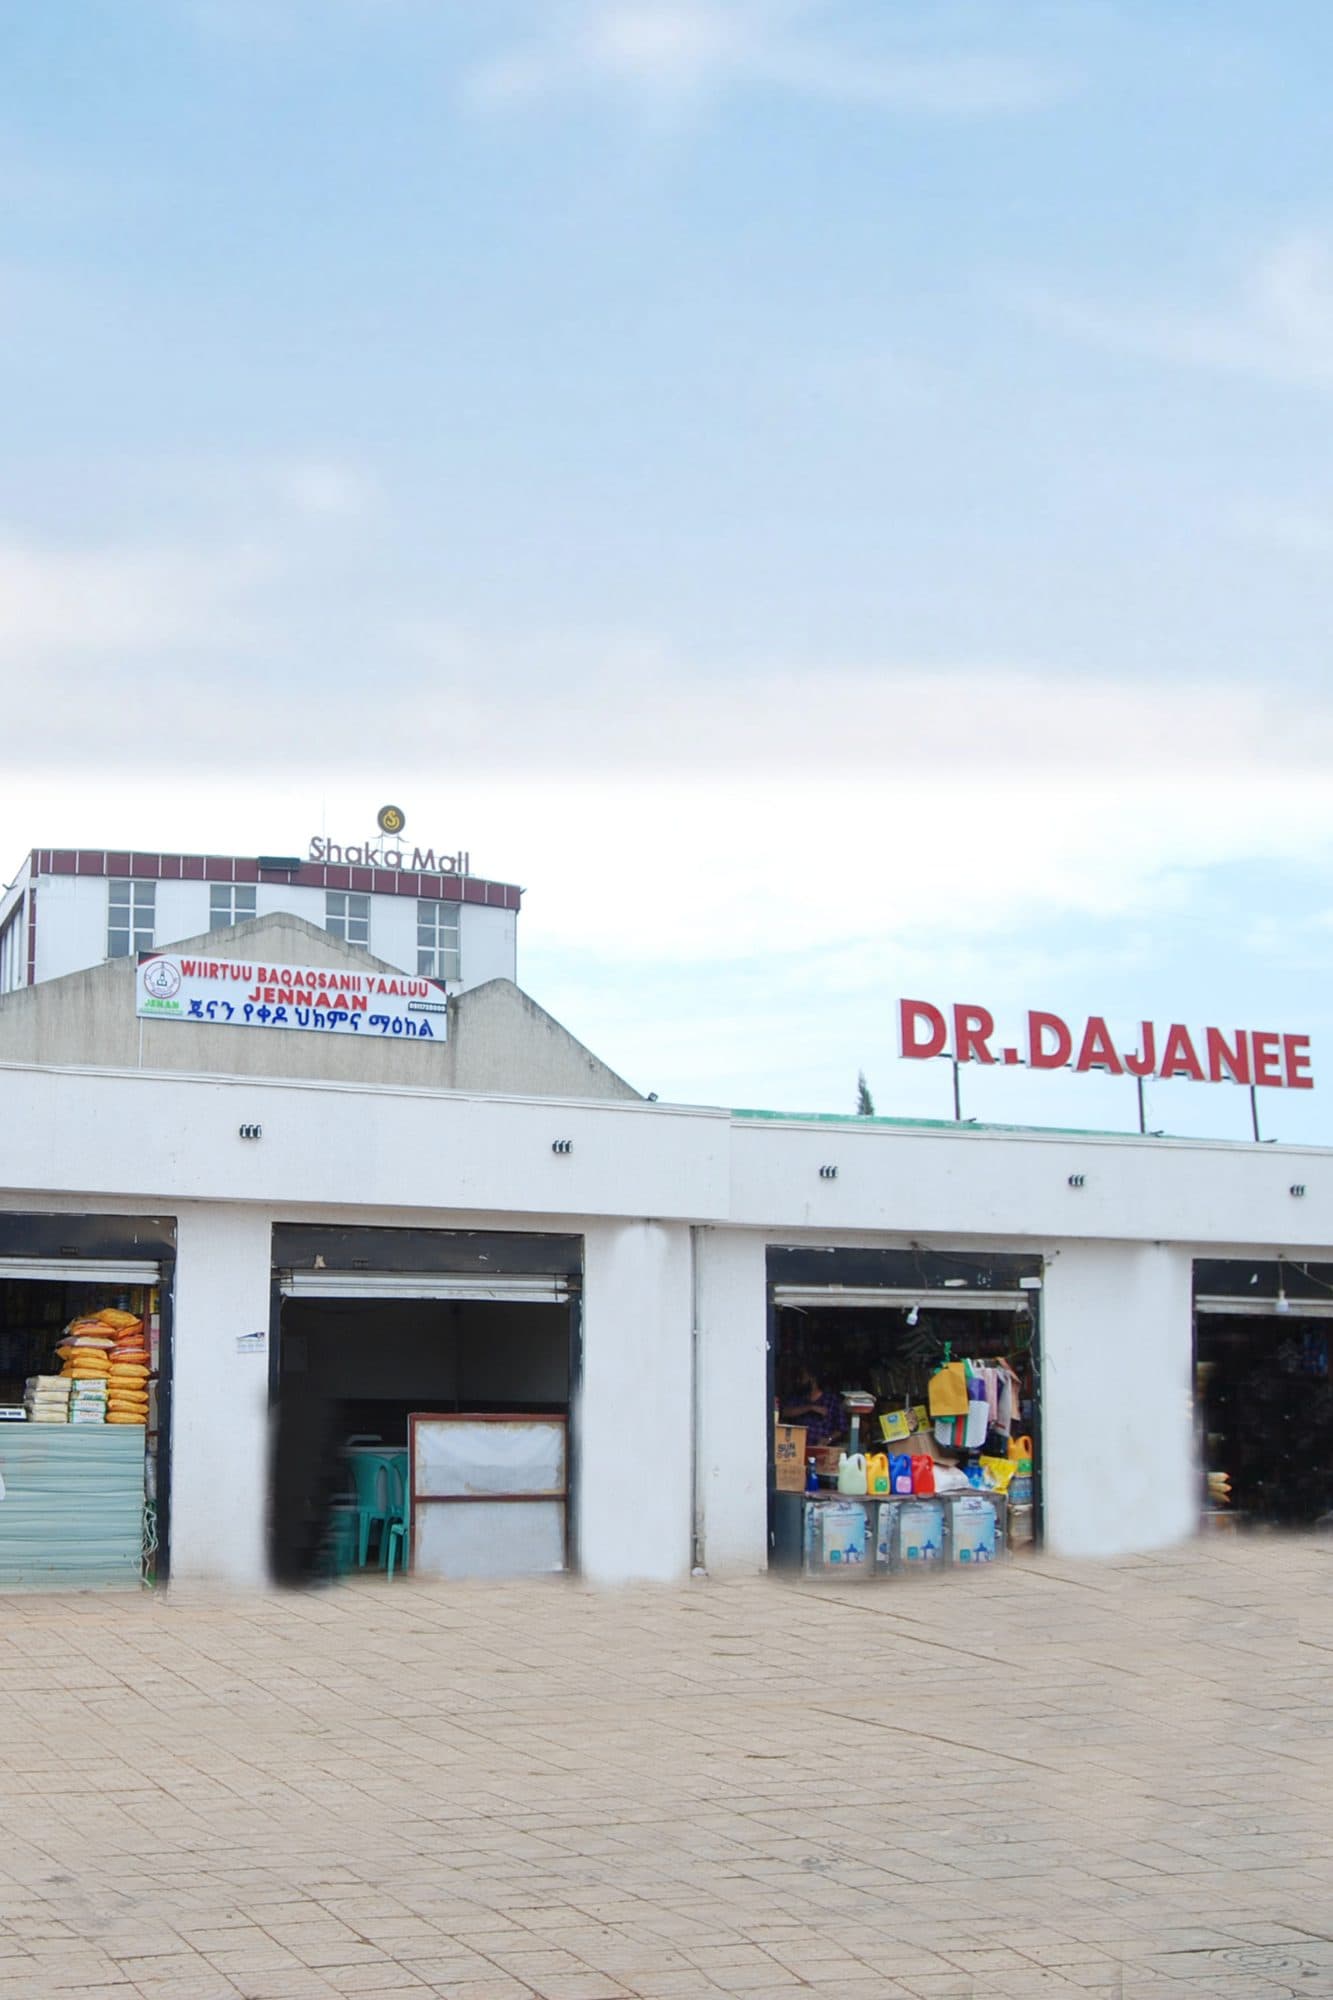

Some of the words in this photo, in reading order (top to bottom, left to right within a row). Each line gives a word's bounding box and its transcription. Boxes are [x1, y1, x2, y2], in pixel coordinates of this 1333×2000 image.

[309, 836, 402, 869] Shaka
[412, 847, 469, 876] Mall
[180, 959, 253, 983] WIIRTUU
[257, 966, 362, 992] BAQAQSANII
[366, 976, 429, 998] YAALUU
[248, 986, 368, 1012] JENNAAN
[243, 1003, 288, 1024] የቀዶ
[294, 1007, 362, 1031] ህክምና
